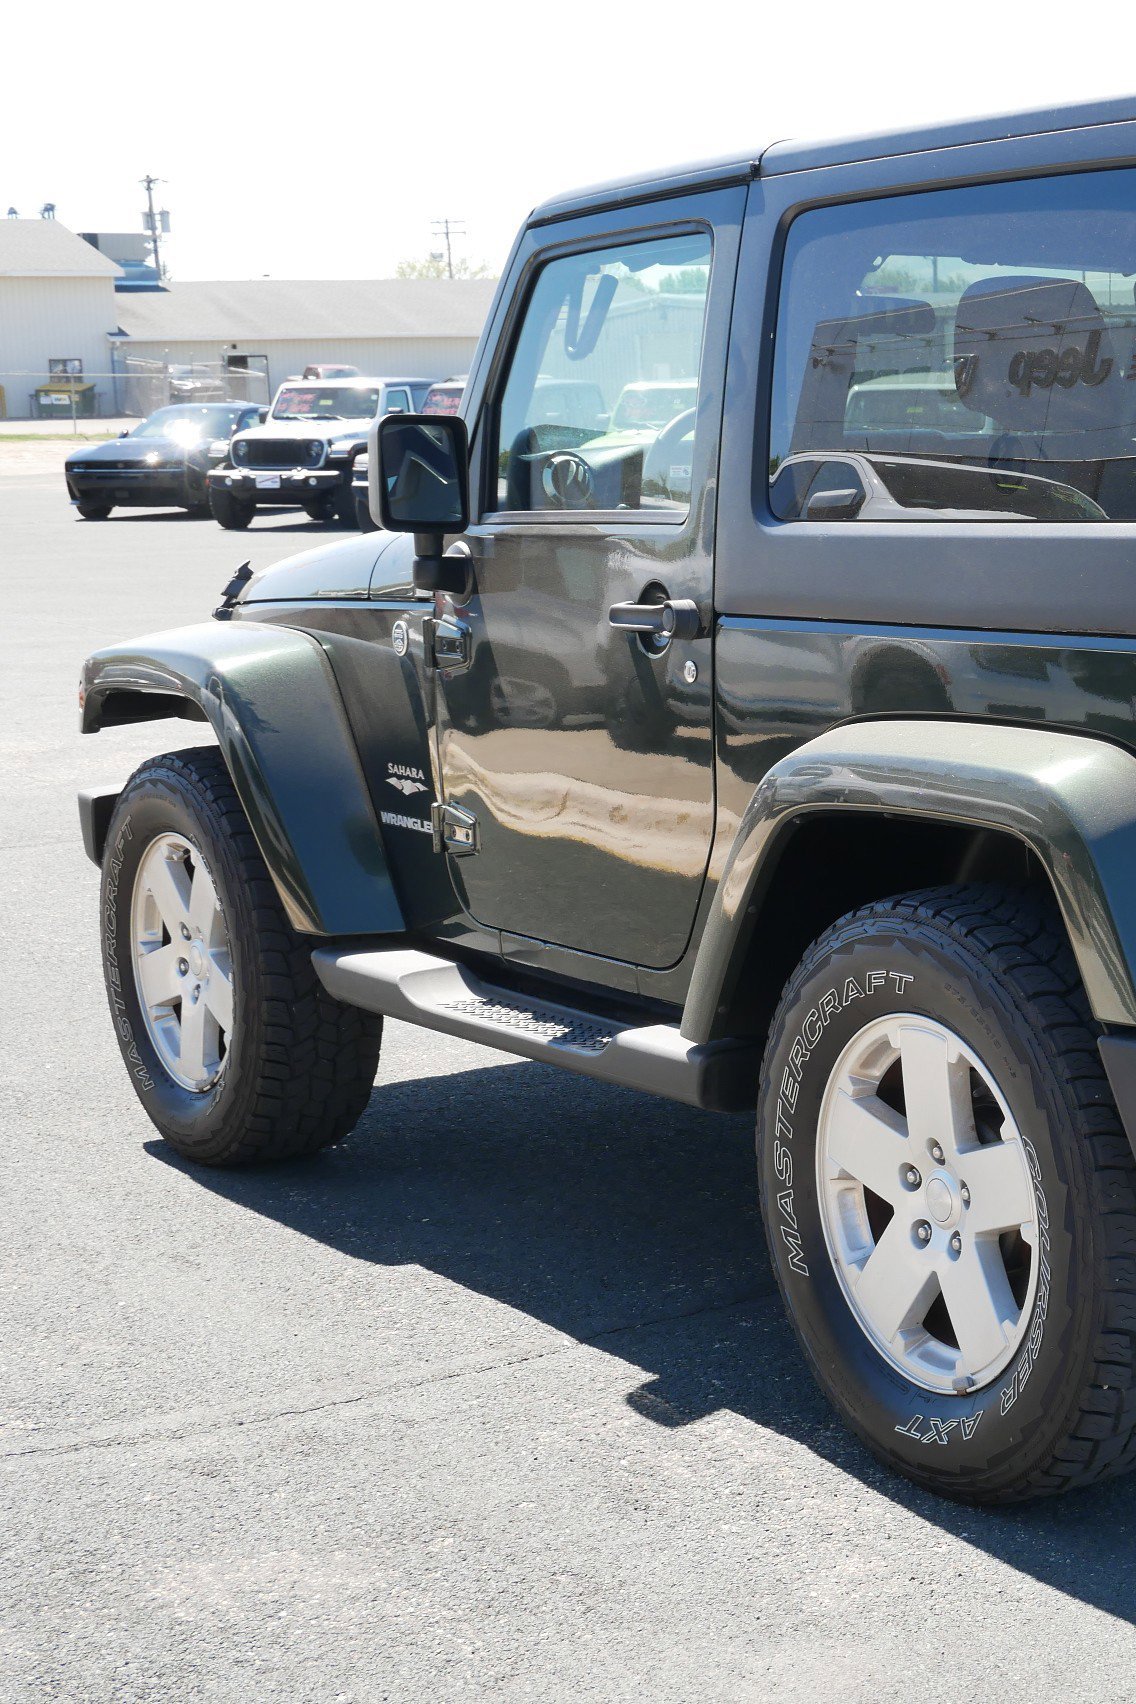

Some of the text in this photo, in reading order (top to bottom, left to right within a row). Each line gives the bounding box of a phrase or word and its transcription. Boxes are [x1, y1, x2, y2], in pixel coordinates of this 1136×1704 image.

[380, 811, 434, 834] WRANGLE
[387, 762, 425, 780] SAHARA
[102, 814, 155, 1091] MASTERCRAFT
[773, 970, 914, 1277] MASTERCRAFT
[1000, 1135, 1051, 1416] COURSER
[894, 1410, 984, 1445] AXT
